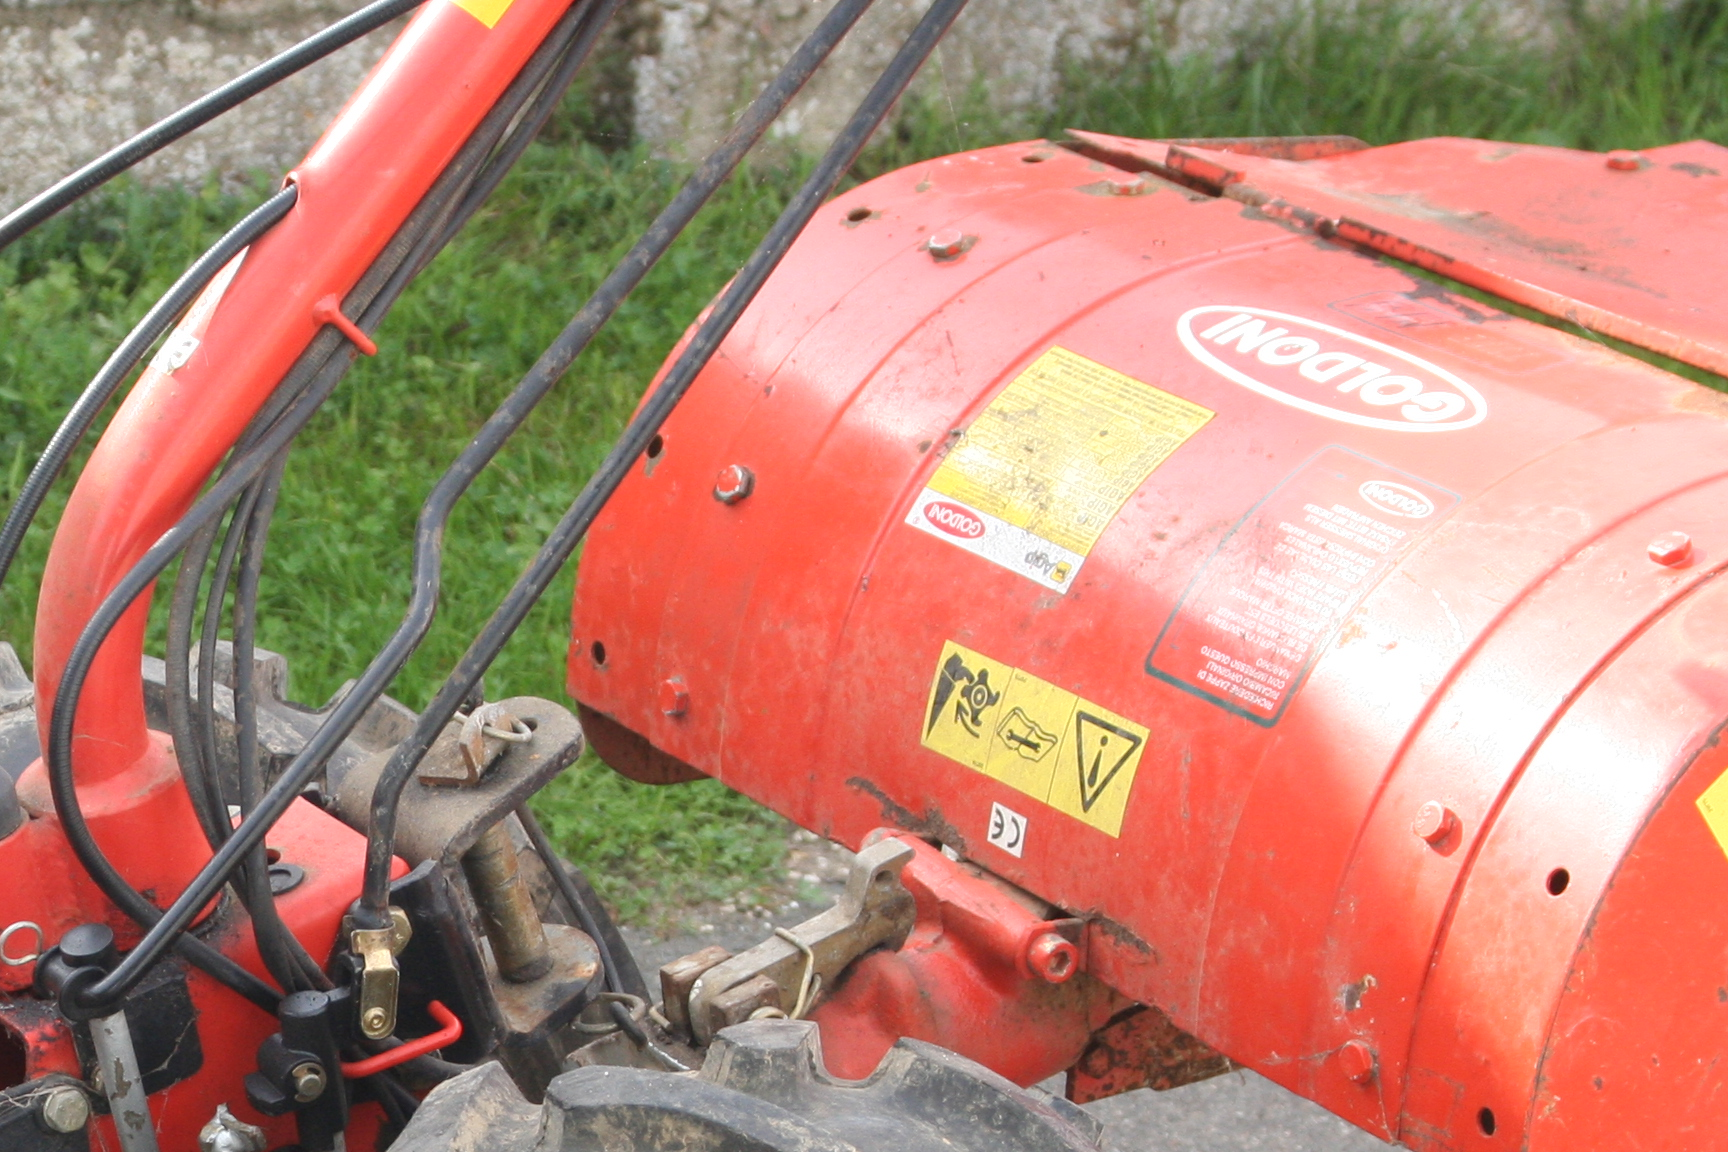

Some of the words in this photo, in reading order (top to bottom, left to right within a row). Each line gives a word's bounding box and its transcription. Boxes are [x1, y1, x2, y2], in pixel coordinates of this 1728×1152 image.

[1200, 313, 1467, 422] GOLDONI
[1363, 479, 1429, 519] GOLDONI
[928, 504, 982, 536] GOLDONI
[1023, 551, 1056, 574] Agip
[1198, 644, 1233, 664] QUESTO
[1194, 668, 1208, 680] DI
[1265, 675, 1287, 689] CON
